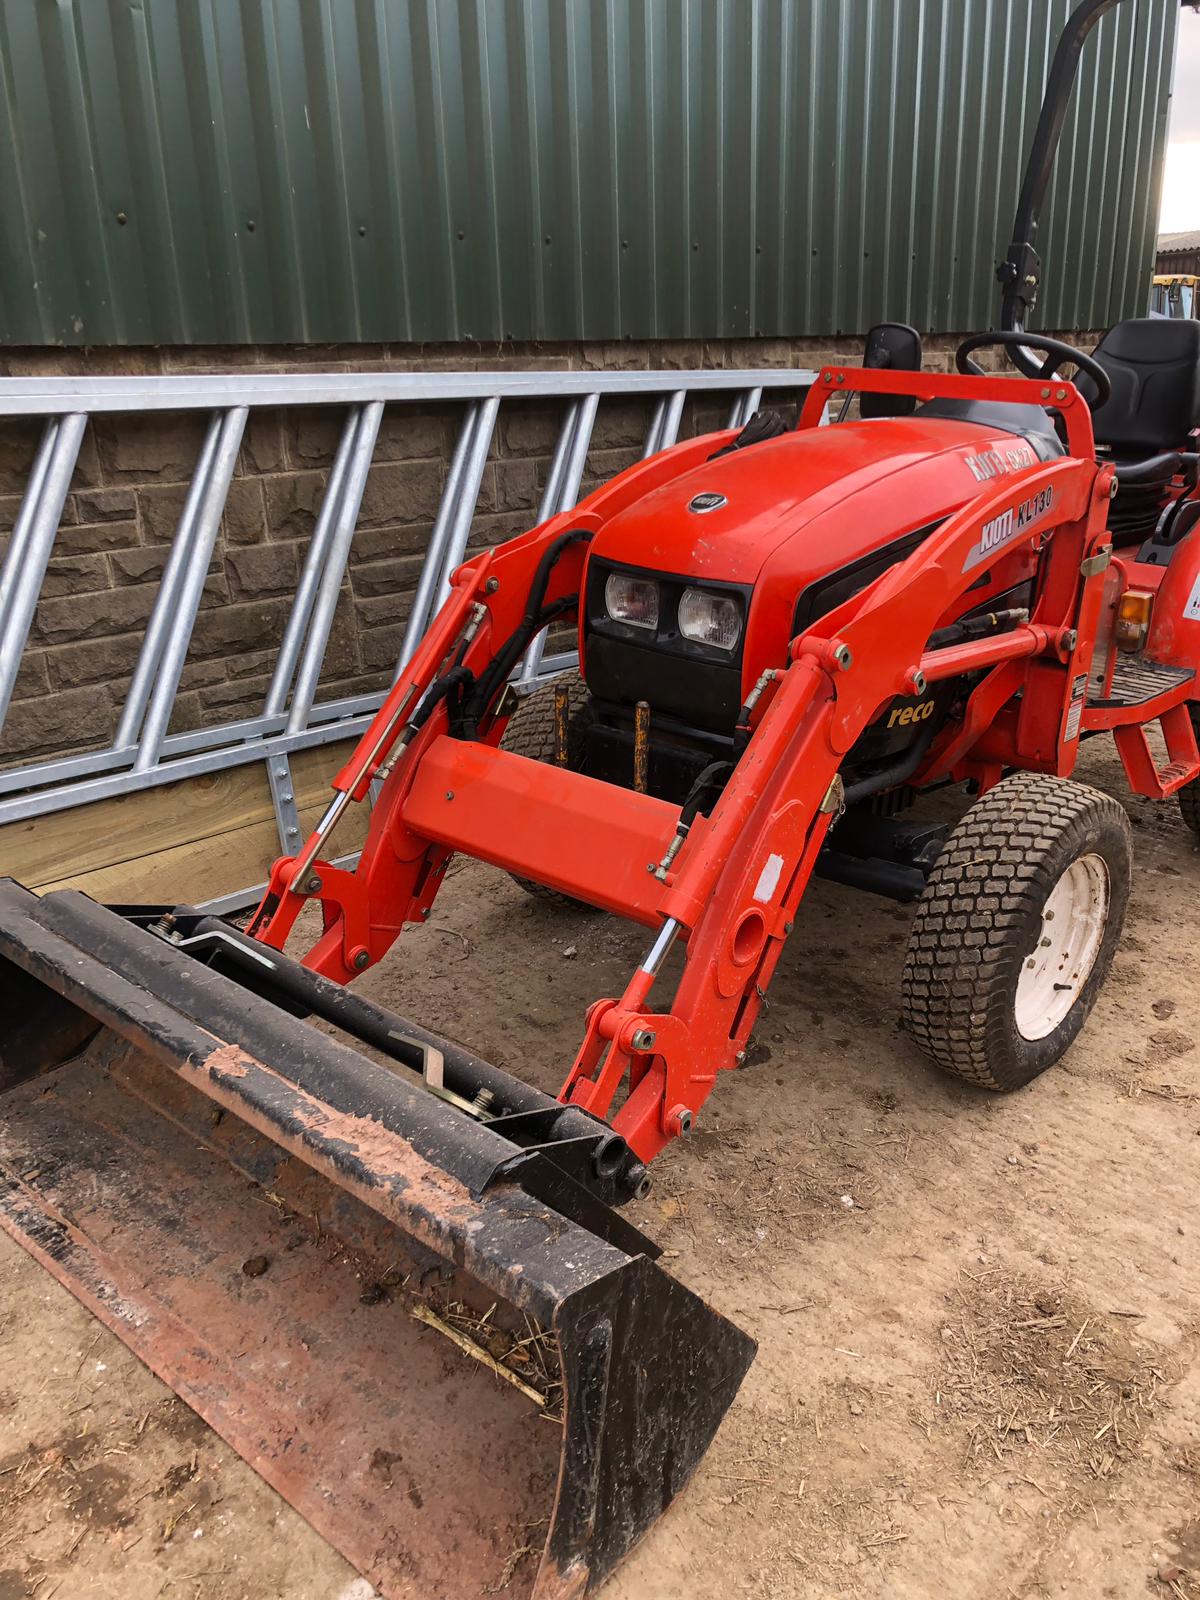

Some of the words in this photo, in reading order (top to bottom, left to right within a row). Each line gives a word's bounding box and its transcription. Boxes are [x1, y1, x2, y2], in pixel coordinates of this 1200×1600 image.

[980, 507, 1014, 555] KIOTI
[1017, 485, 1053, 528] KL130
[886, 700, 935, 729] reco
